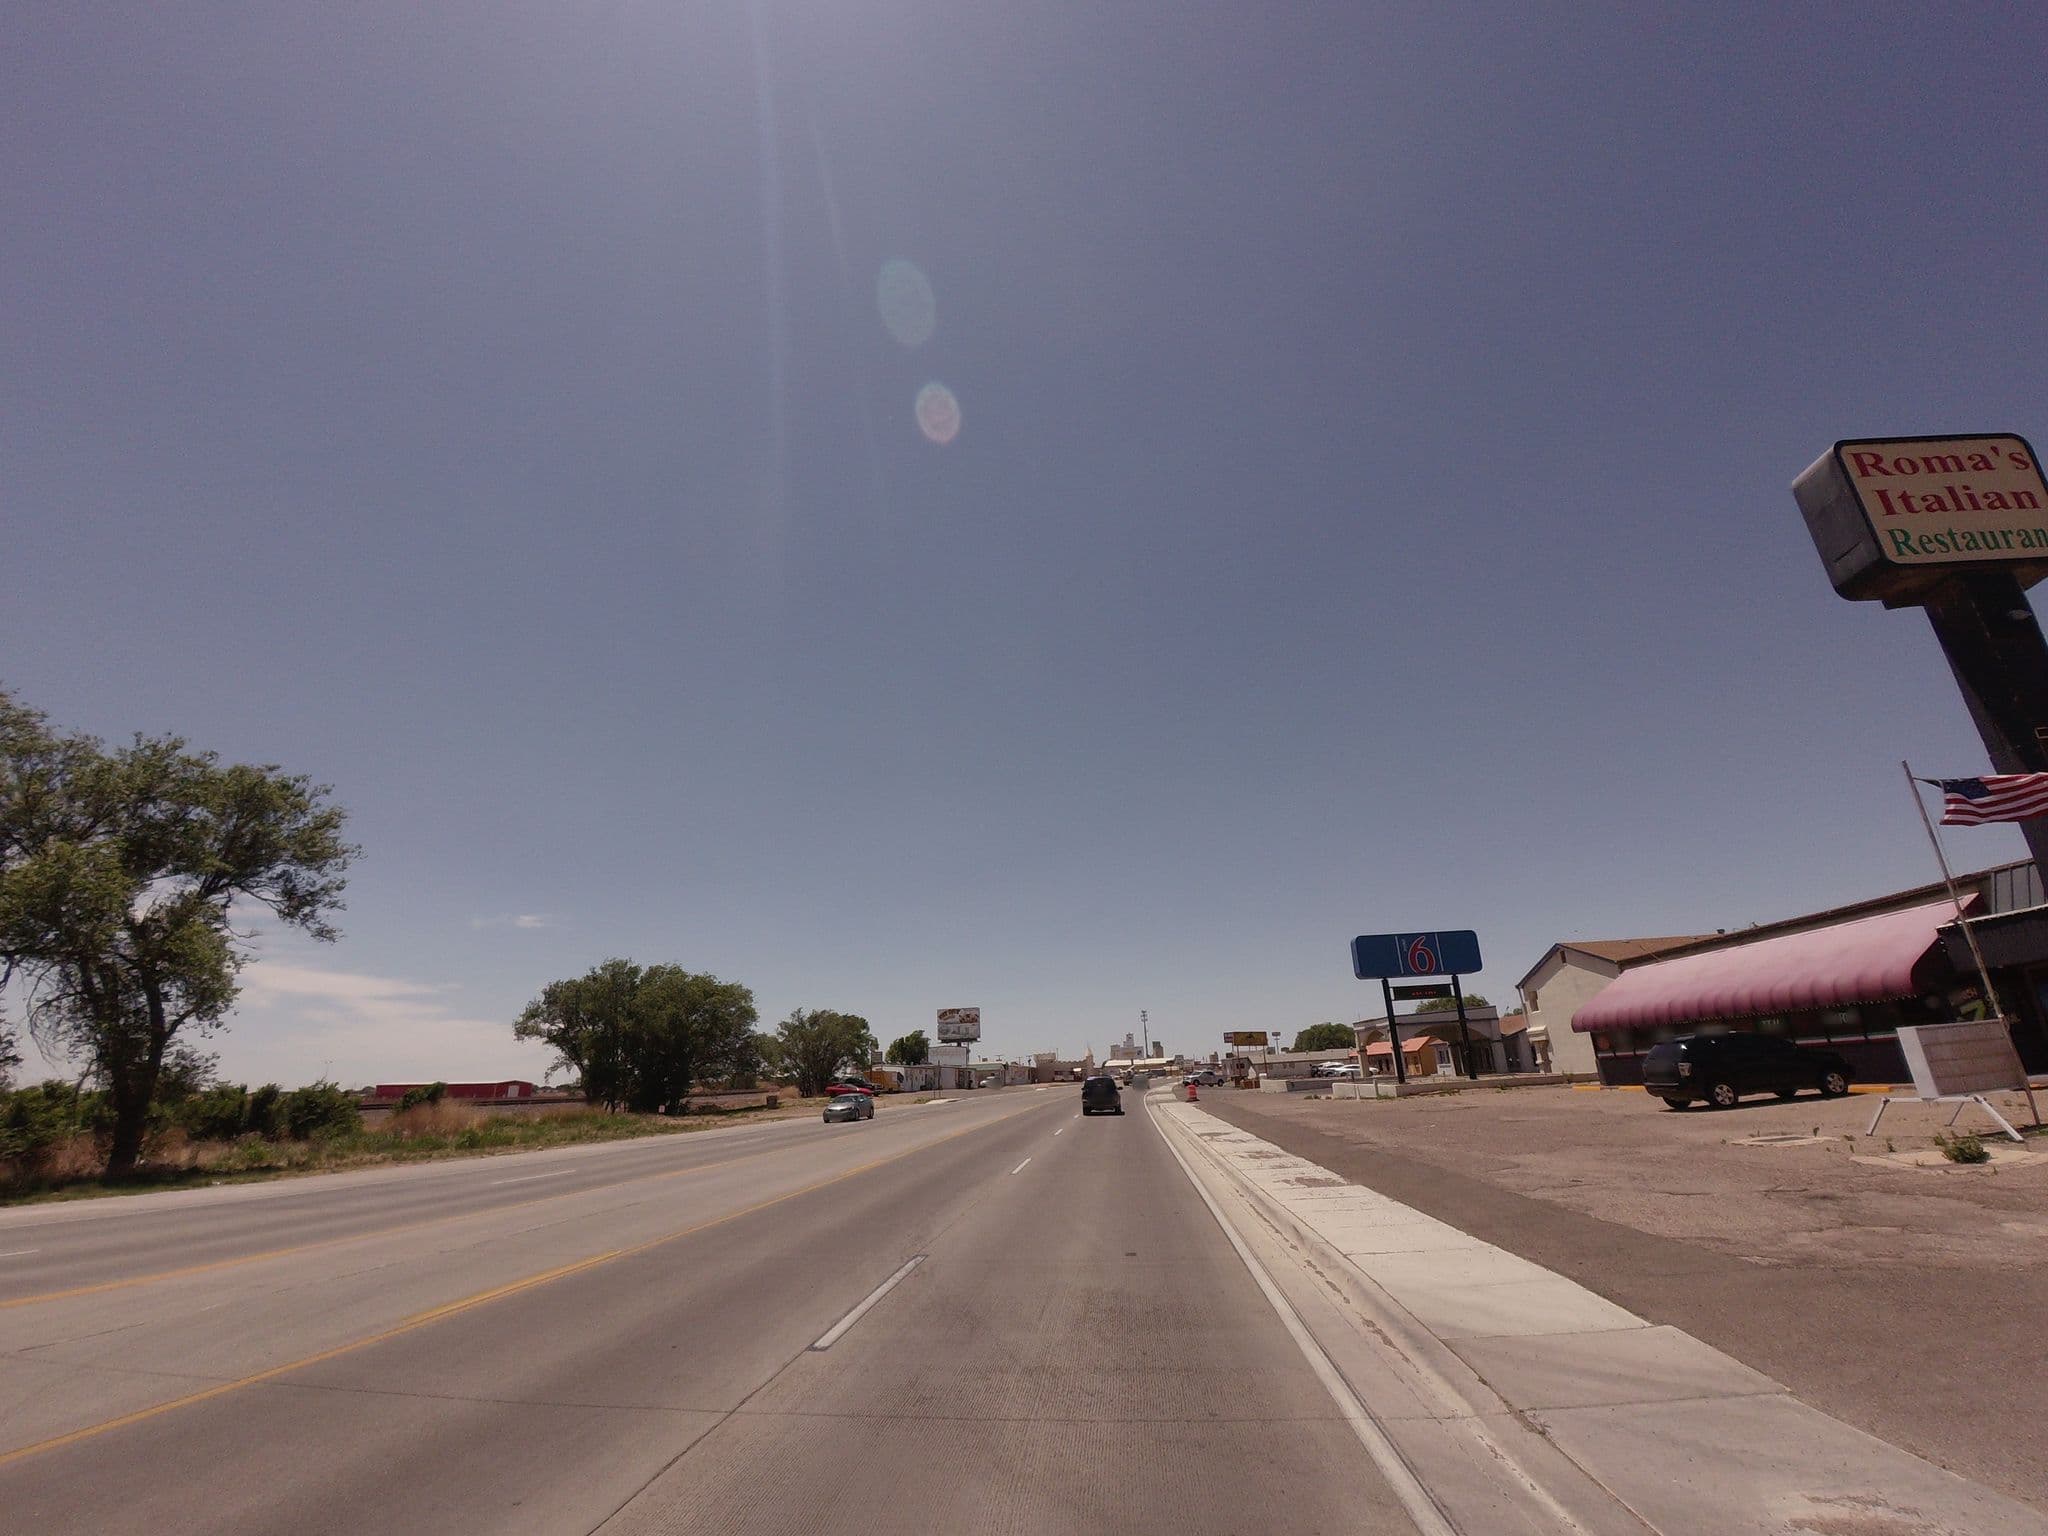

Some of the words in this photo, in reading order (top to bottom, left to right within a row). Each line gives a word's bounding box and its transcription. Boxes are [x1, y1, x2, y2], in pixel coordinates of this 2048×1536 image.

[1848, 445, 2031, 478] Roma's
[1874, 485, 2041, 516] Italian
[1407, 935, 1436, 976] 6
